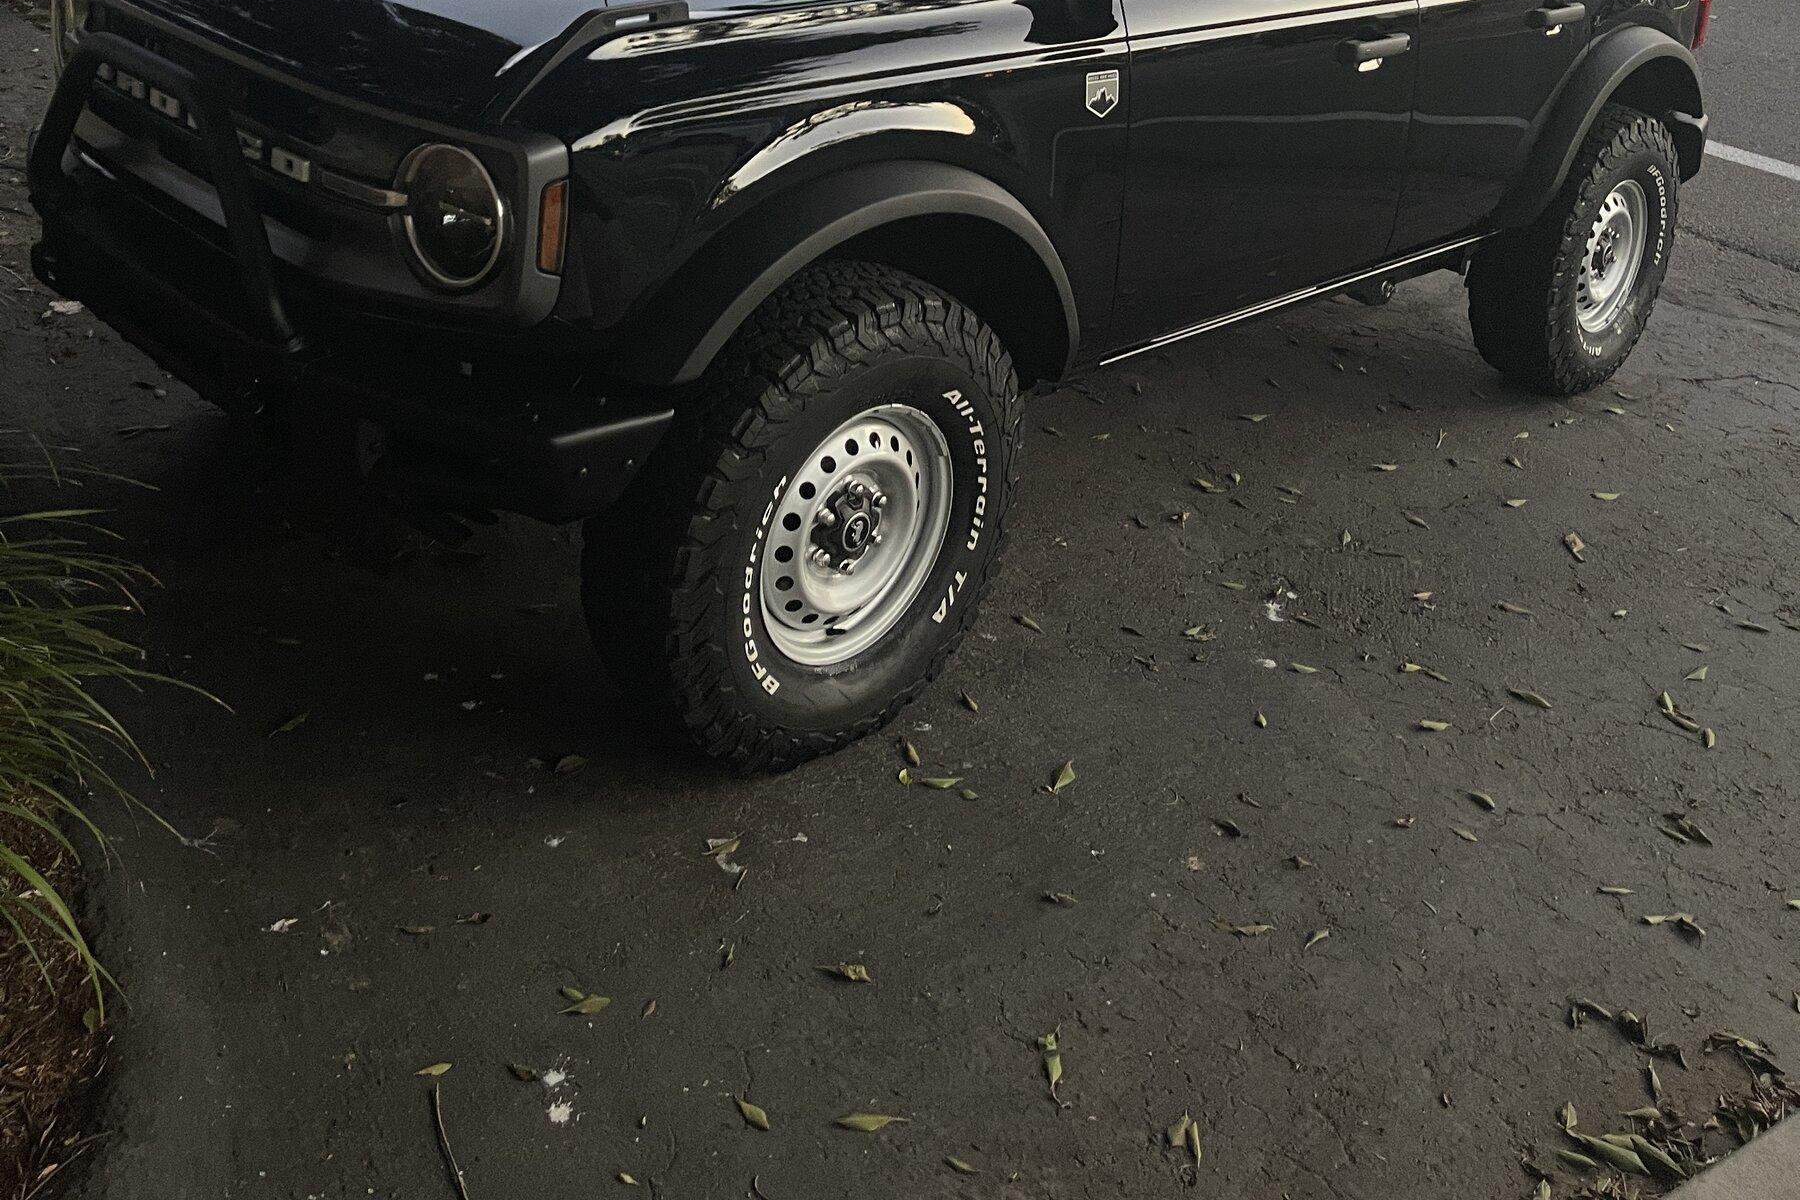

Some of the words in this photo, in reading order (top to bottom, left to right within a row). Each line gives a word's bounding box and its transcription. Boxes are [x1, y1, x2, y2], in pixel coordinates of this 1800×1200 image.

[942, 388, 987, 552] All-Terrain
[743, 475, 787, 696] BFGoodrich
[932, 570, 968, 624] T/A
